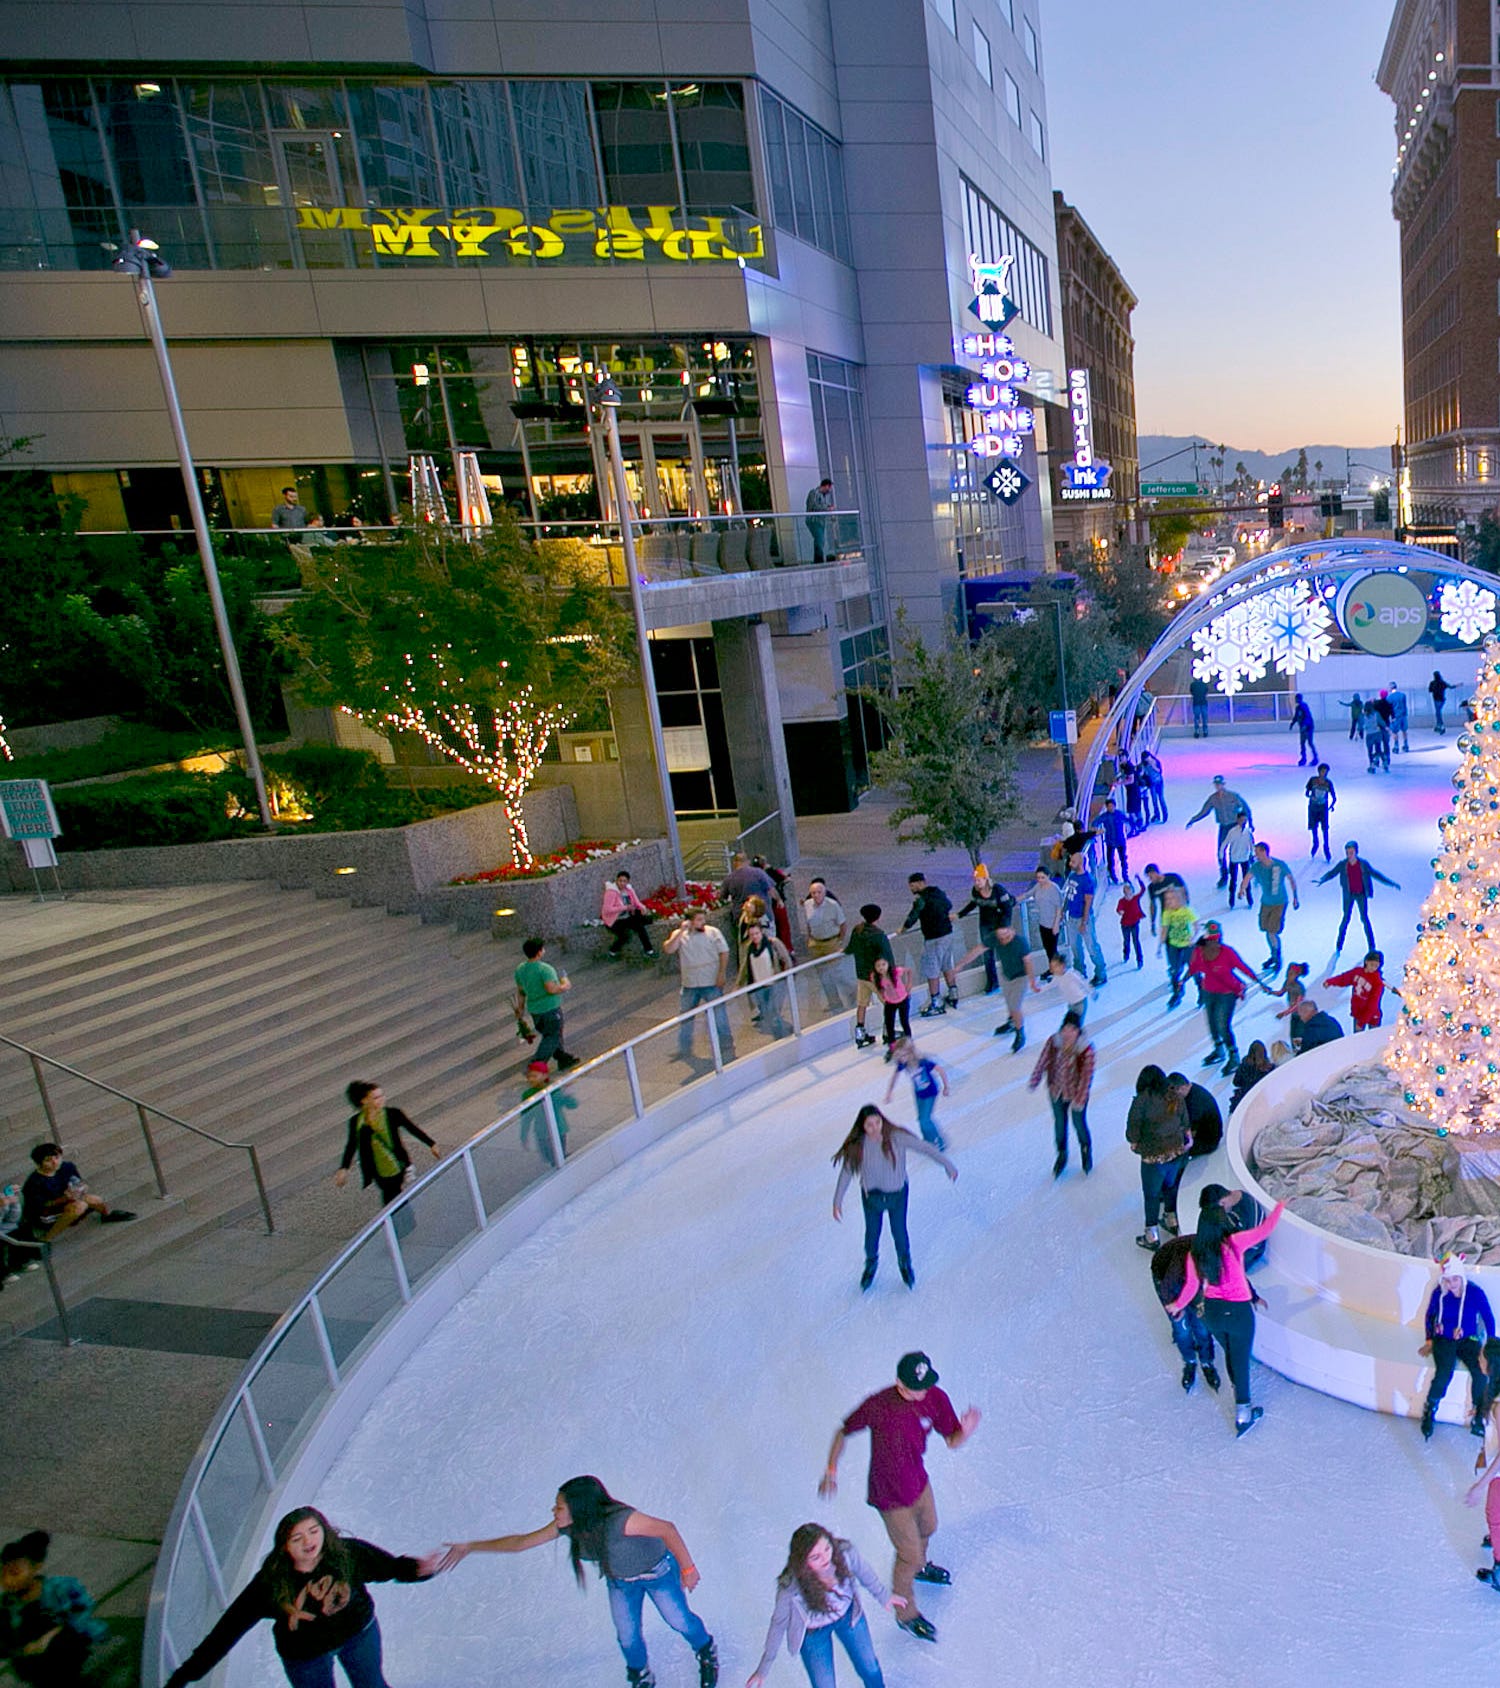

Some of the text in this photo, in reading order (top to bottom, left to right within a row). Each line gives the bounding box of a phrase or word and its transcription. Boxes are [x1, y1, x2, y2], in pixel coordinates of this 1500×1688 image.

[977, 334, 1018, 456] HOUND
[1070, 369, 1092, 468] squid
[1061, 487, 1111, 500] SUSHI BAR
[1147, 486, 1188, 494] Jefferson
[1379, 606, 1422, 629] aps
[12, 822, 55, 834] HERE
